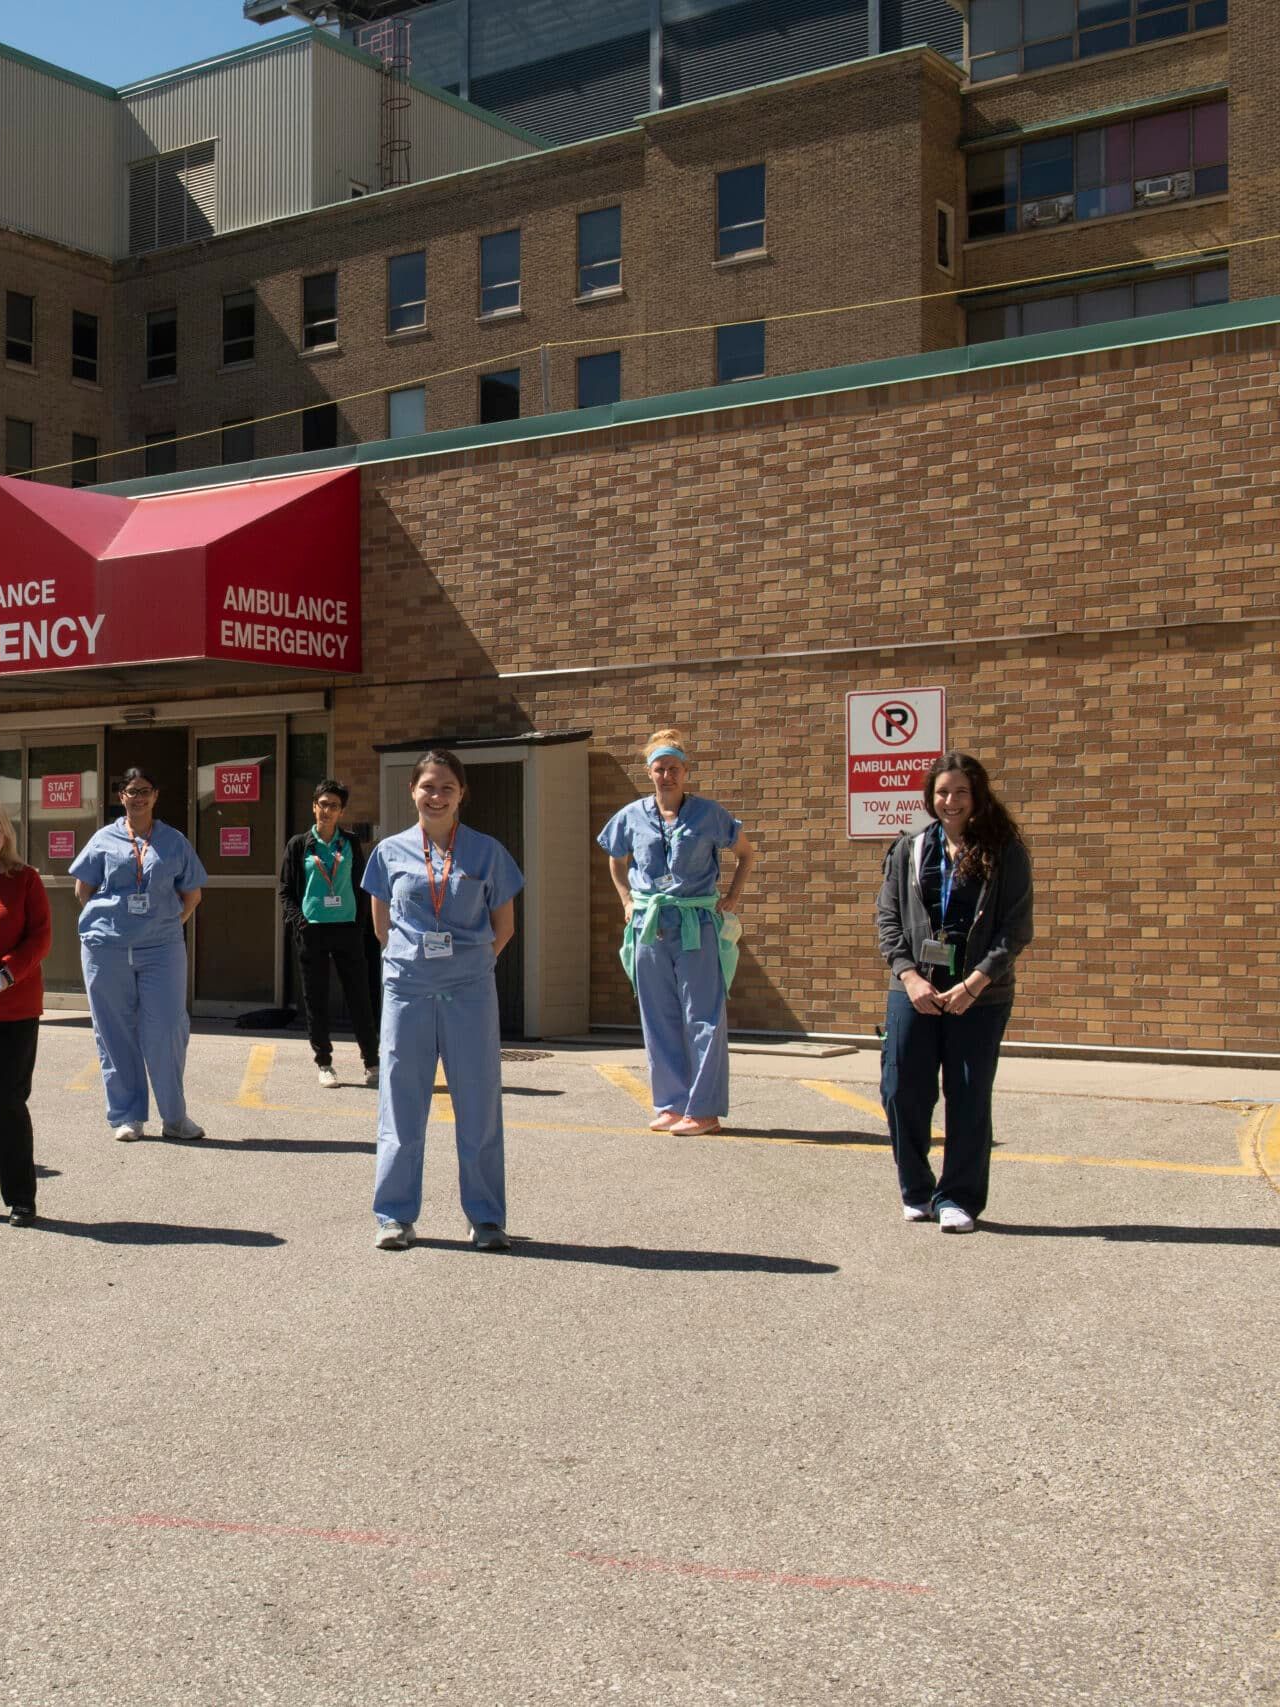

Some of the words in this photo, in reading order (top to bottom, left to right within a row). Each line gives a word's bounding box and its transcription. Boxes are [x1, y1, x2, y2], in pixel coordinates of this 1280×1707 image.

[223, 585, 348, 625] AMBULANCE
[221, 620, 348, 659] EMERGENCY
[221, 772, 253, 784] STAFF
[879, 774, 911, 787] ONLY
[47, 781, 75, 792] STAFF
[223, 784, 251, 795] ONLY
[49, 791, 73, 802] ONLY
[863, 801, 891, 812] TOW
[878, 813, 913, 825] ZONE
